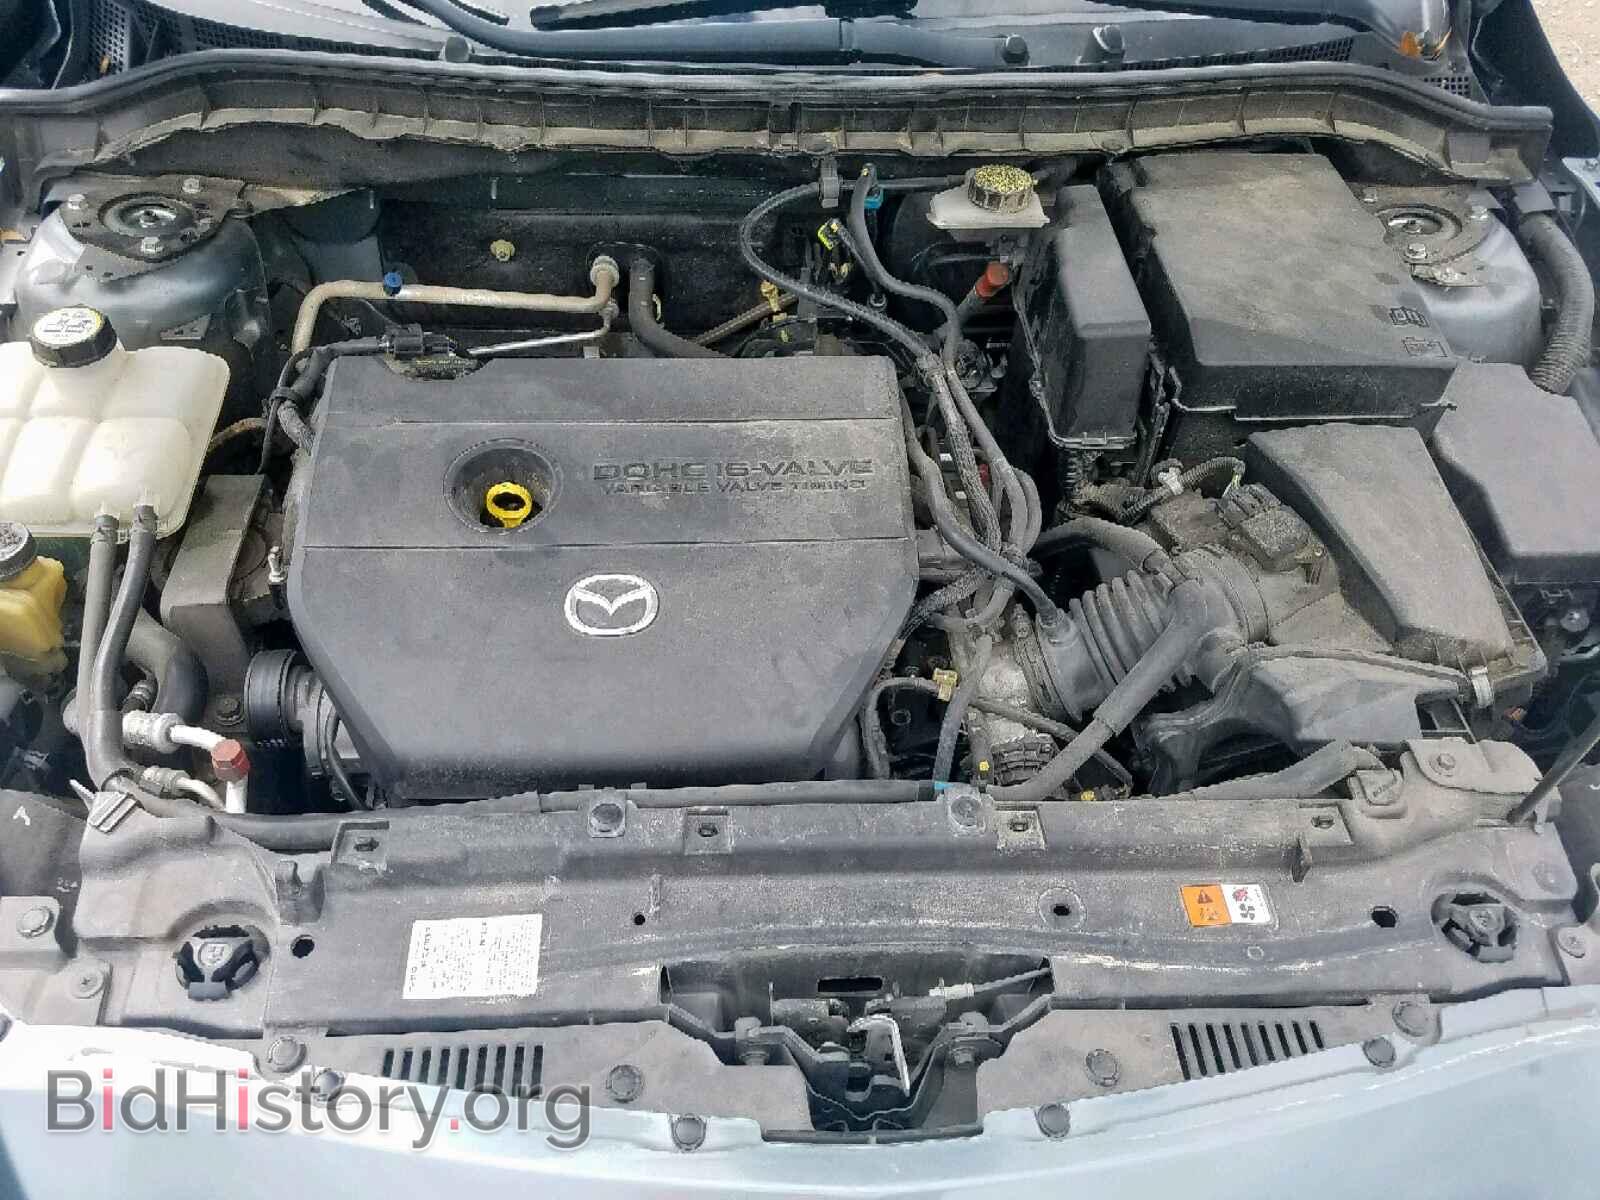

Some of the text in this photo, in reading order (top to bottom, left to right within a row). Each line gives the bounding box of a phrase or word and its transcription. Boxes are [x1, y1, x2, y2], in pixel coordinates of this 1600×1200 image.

[593, 458, 874, 481] DOHC 16-VALVE
[716, 480, 784, 493] VALVE
